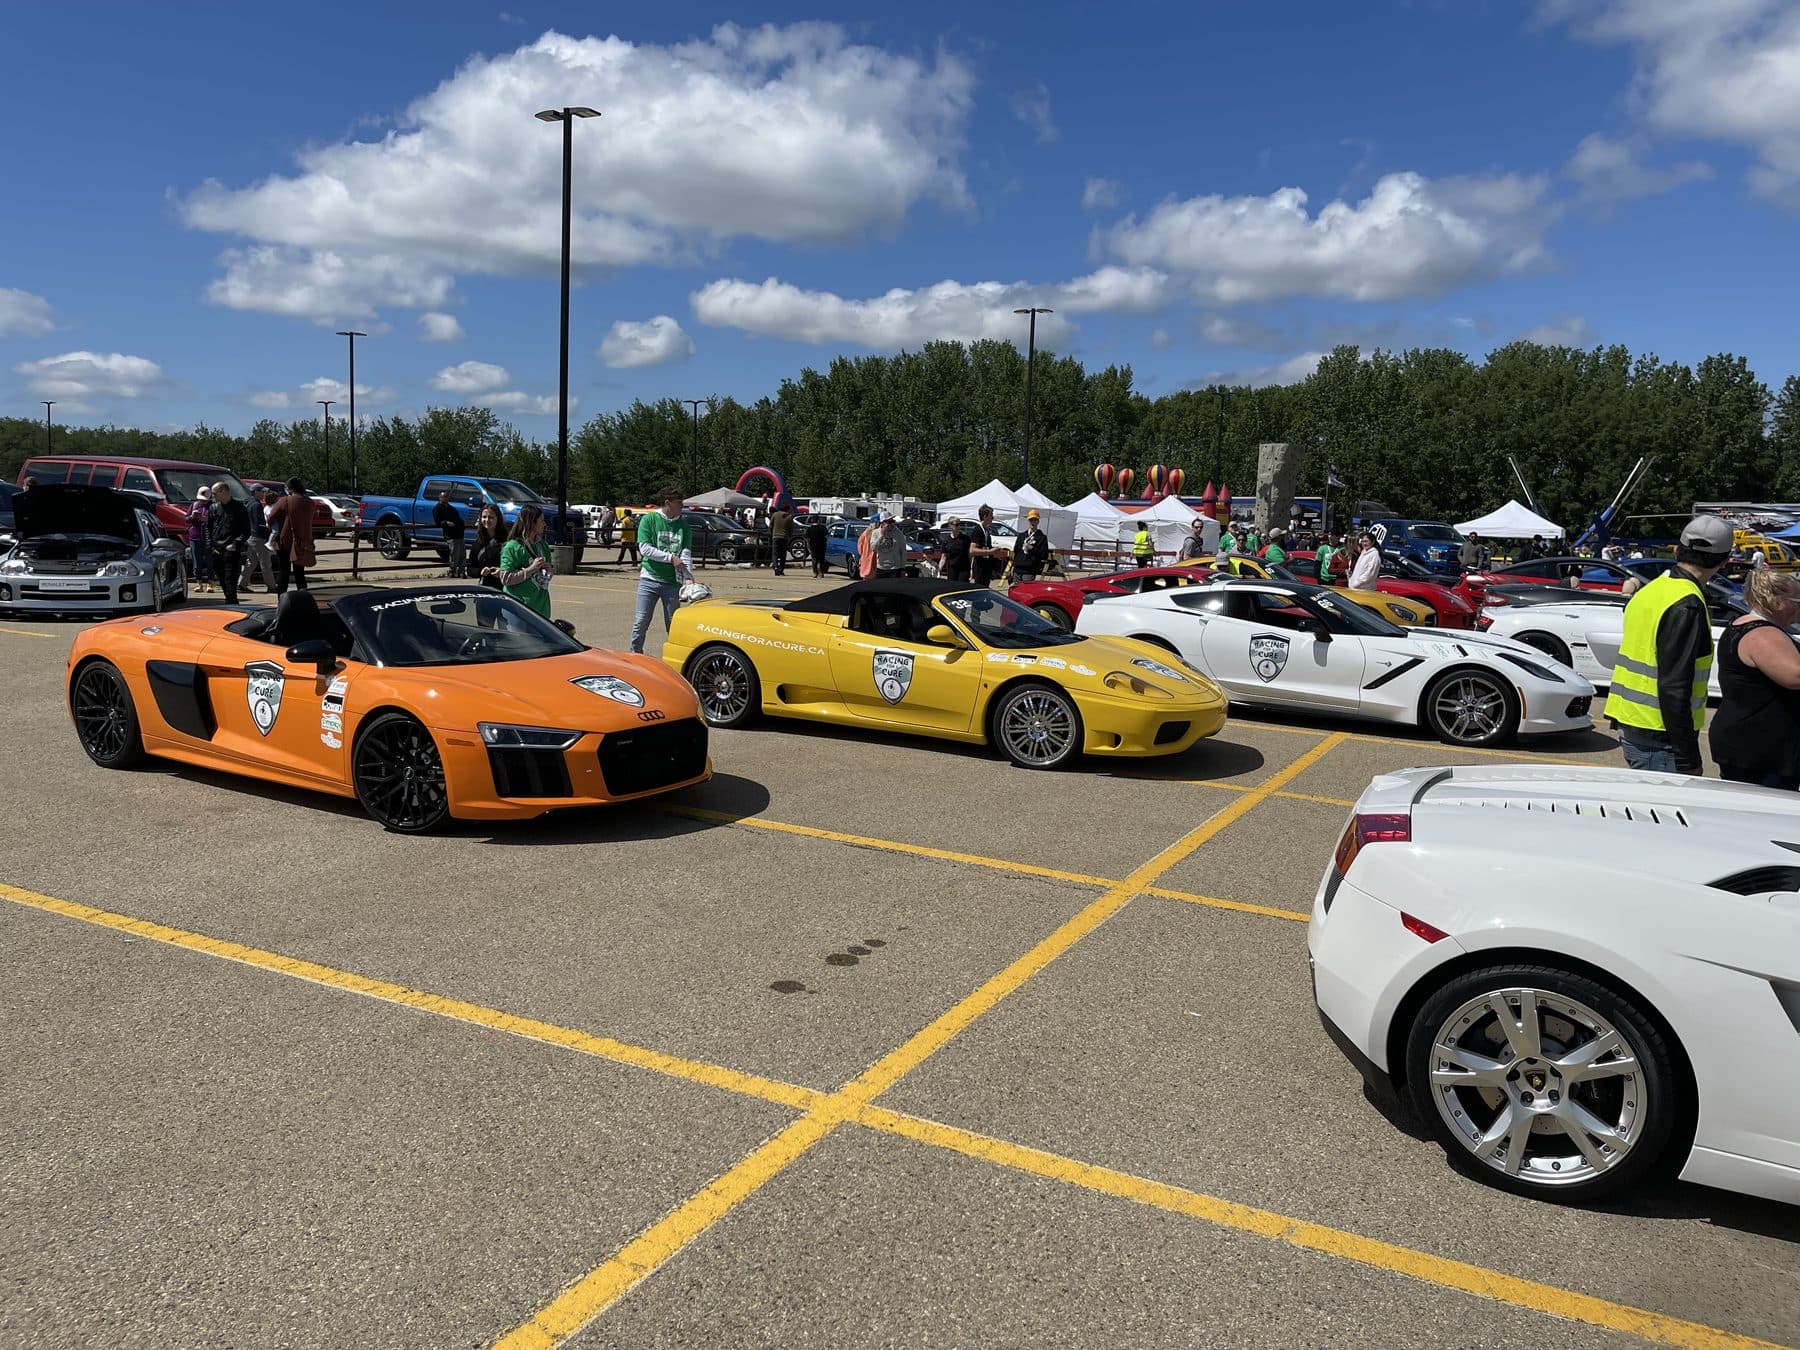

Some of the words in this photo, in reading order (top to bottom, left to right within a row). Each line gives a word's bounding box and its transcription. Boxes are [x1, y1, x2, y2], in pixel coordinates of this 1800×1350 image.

[696, 623, 825, 656] RACINGFORACURE.CA
[1254, 640, 1285, 649] RACING
[878, 655, 909, 666] RACING
[1258, 651, 1279, 660] CURE
[881, 668, 903, 678] CURE
[254, 686, 274, 699] CURE
